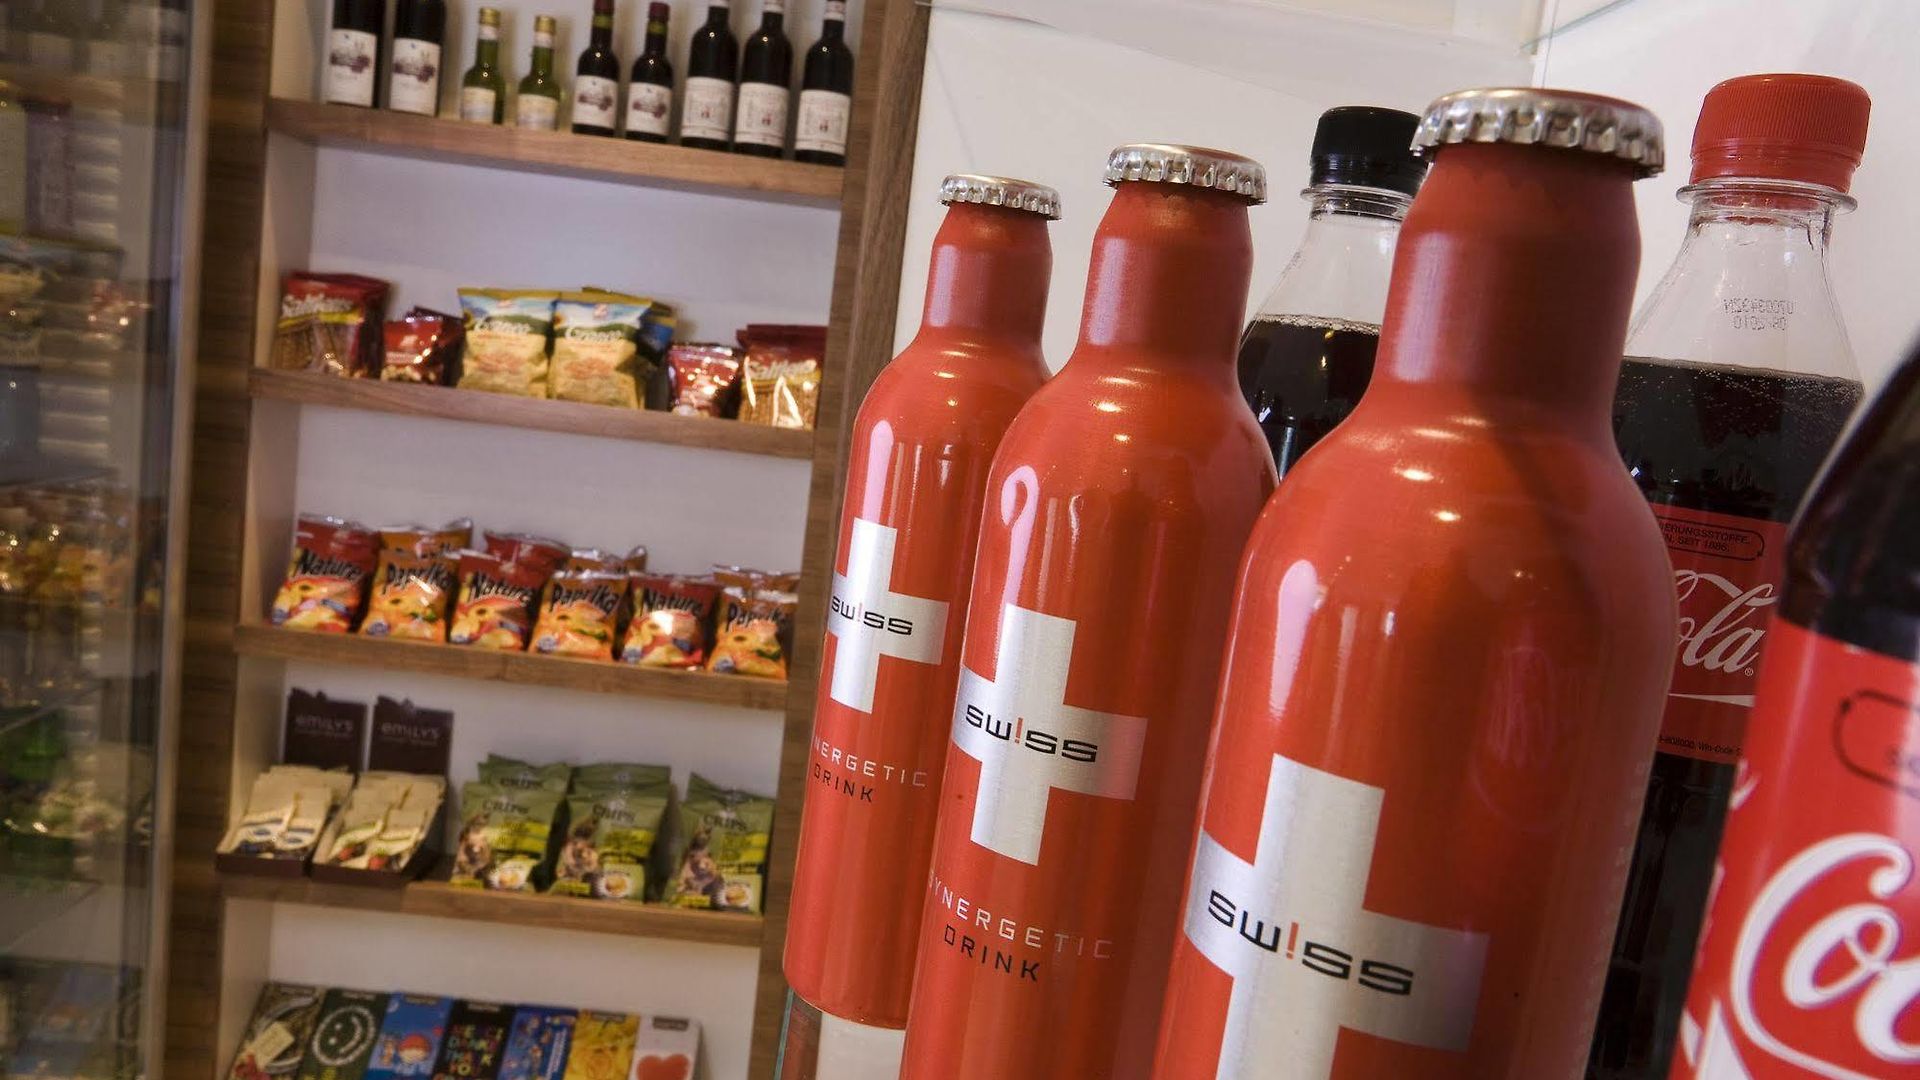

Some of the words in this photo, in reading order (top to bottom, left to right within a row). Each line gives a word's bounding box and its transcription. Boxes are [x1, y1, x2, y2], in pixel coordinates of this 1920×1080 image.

[813, 736, 928, 788] NERGETIC
[813, 762, 875, 803] DRINK
[943, 923, 1040, 982] DRINK
